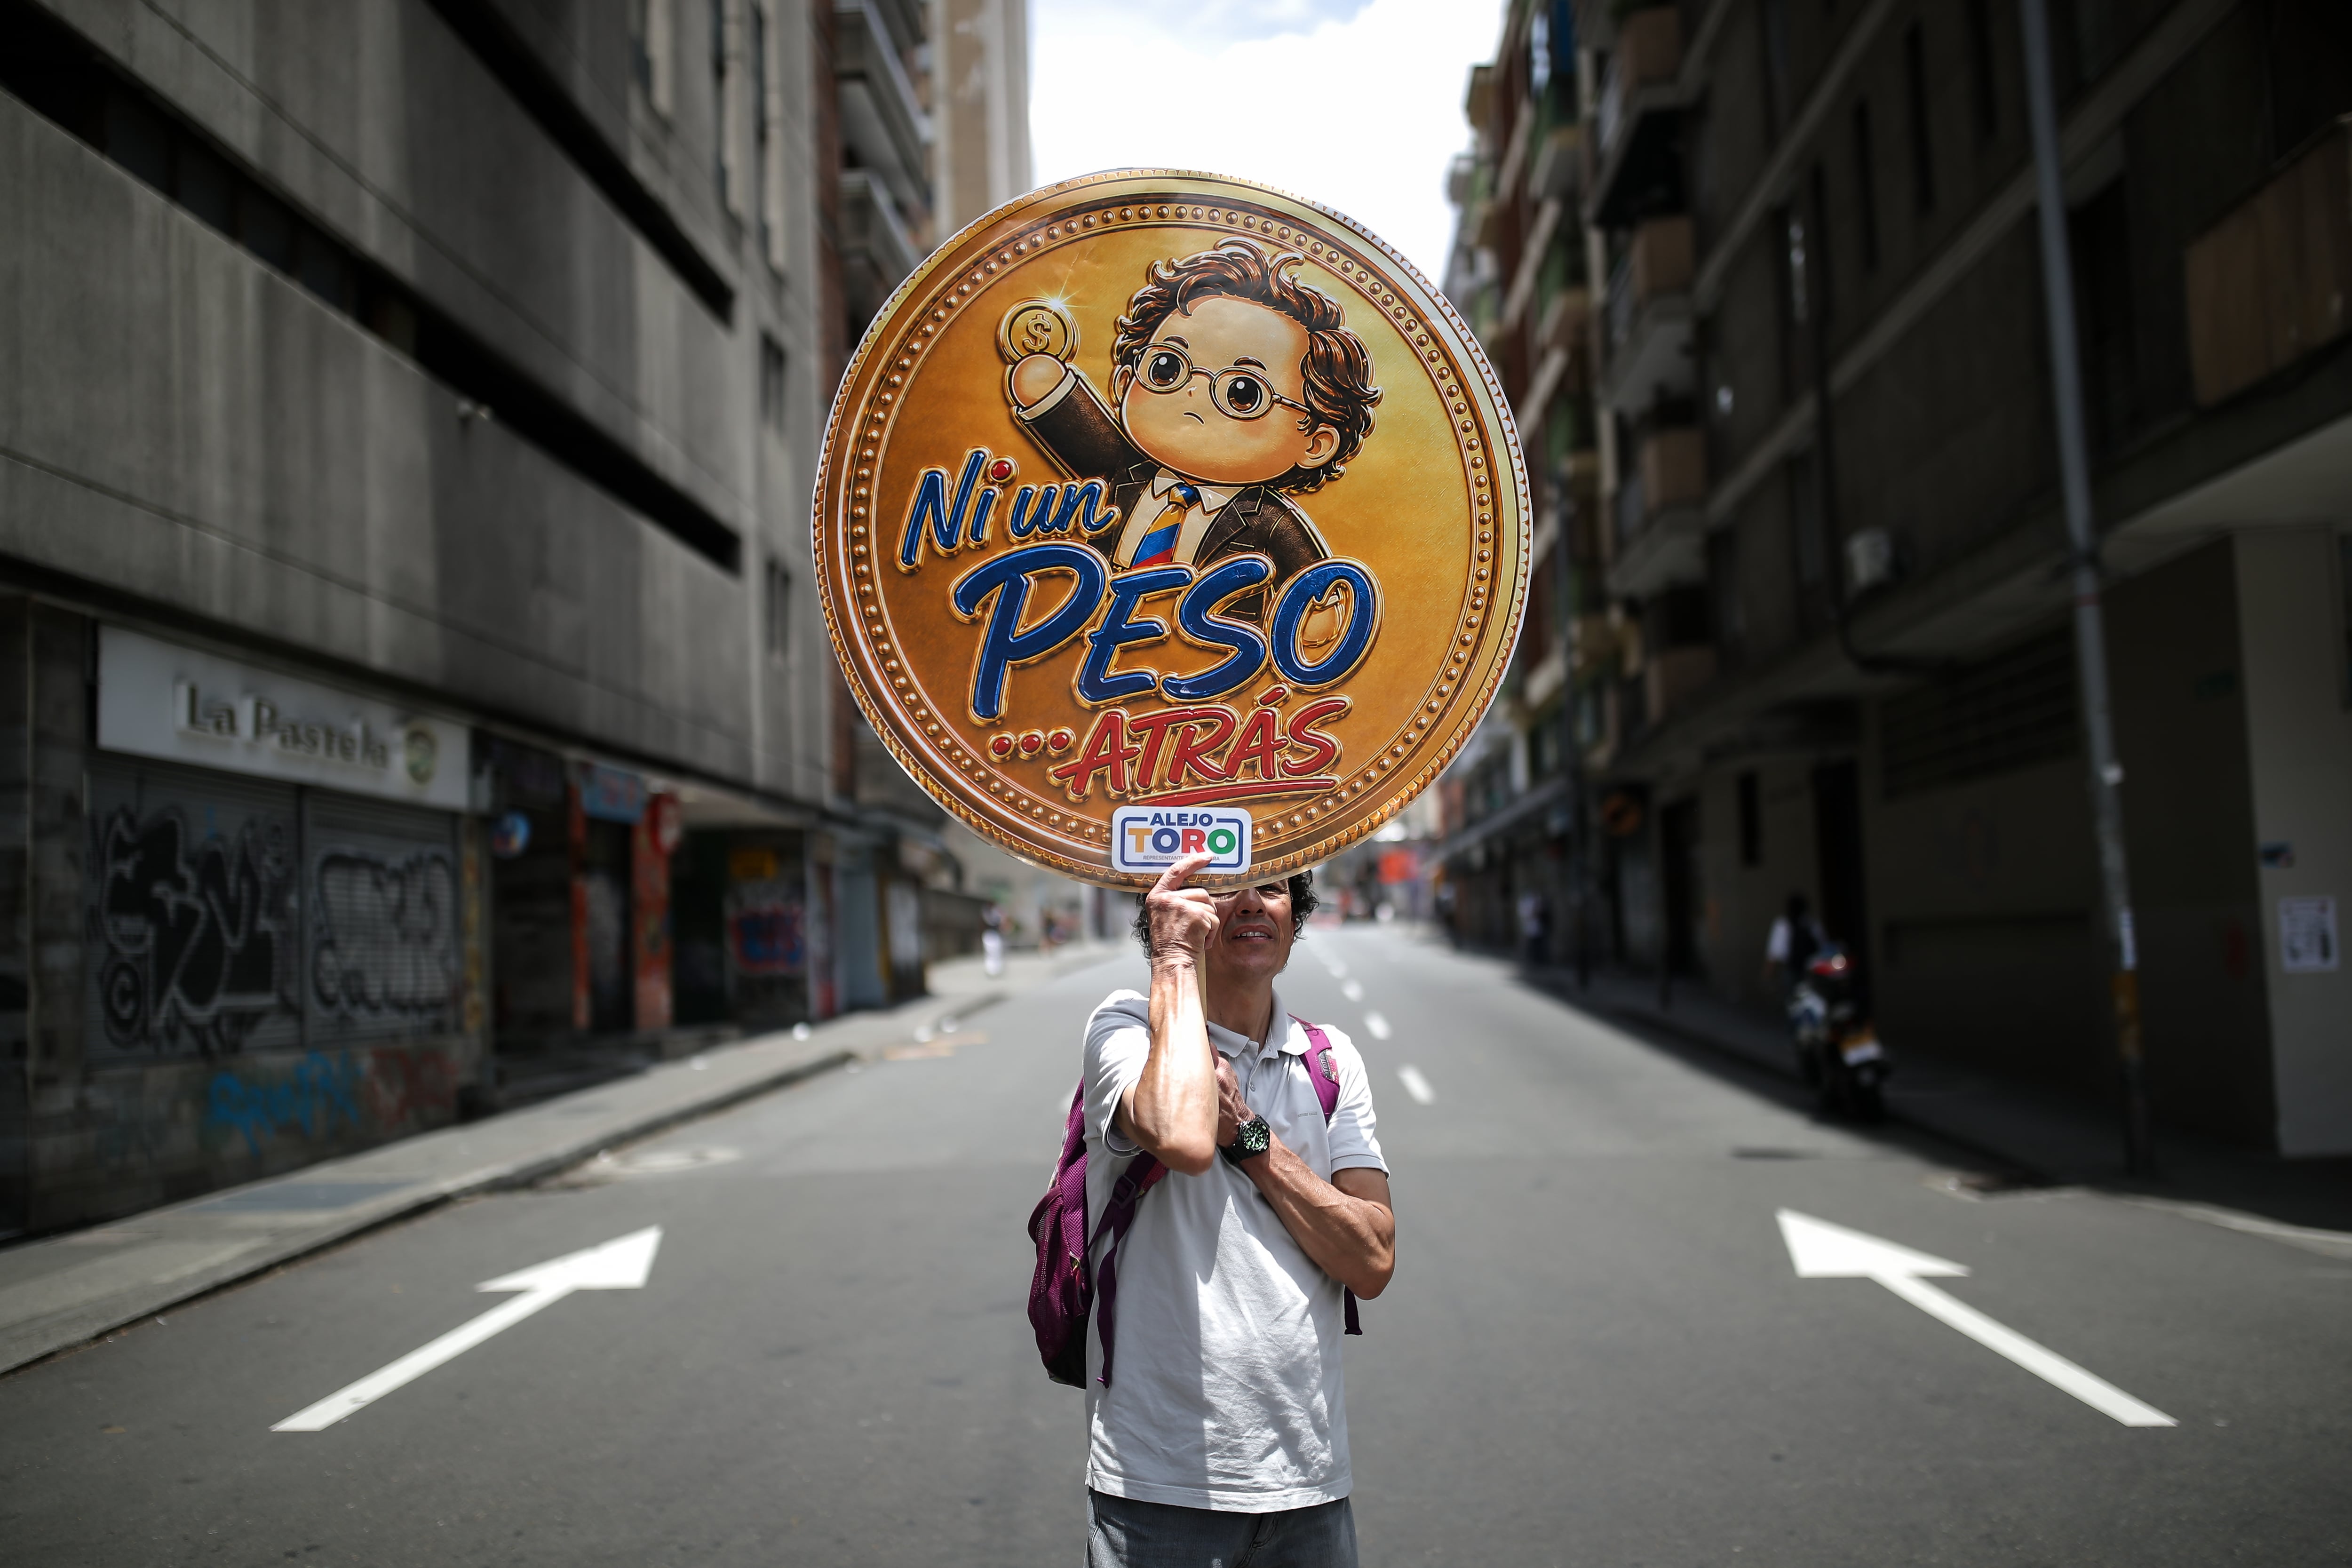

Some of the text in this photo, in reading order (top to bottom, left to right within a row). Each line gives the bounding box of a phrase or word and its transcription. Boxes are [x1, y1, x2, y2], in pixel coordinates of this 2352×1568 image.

[900, 450, 1115, 567] Ni un
[953, 543, 1374, 718] PESO
[180, 680, 237, 737] La
[1128, 828, 1236, 854] TORO
[1150, 812, 1213, 827] ALEJO
